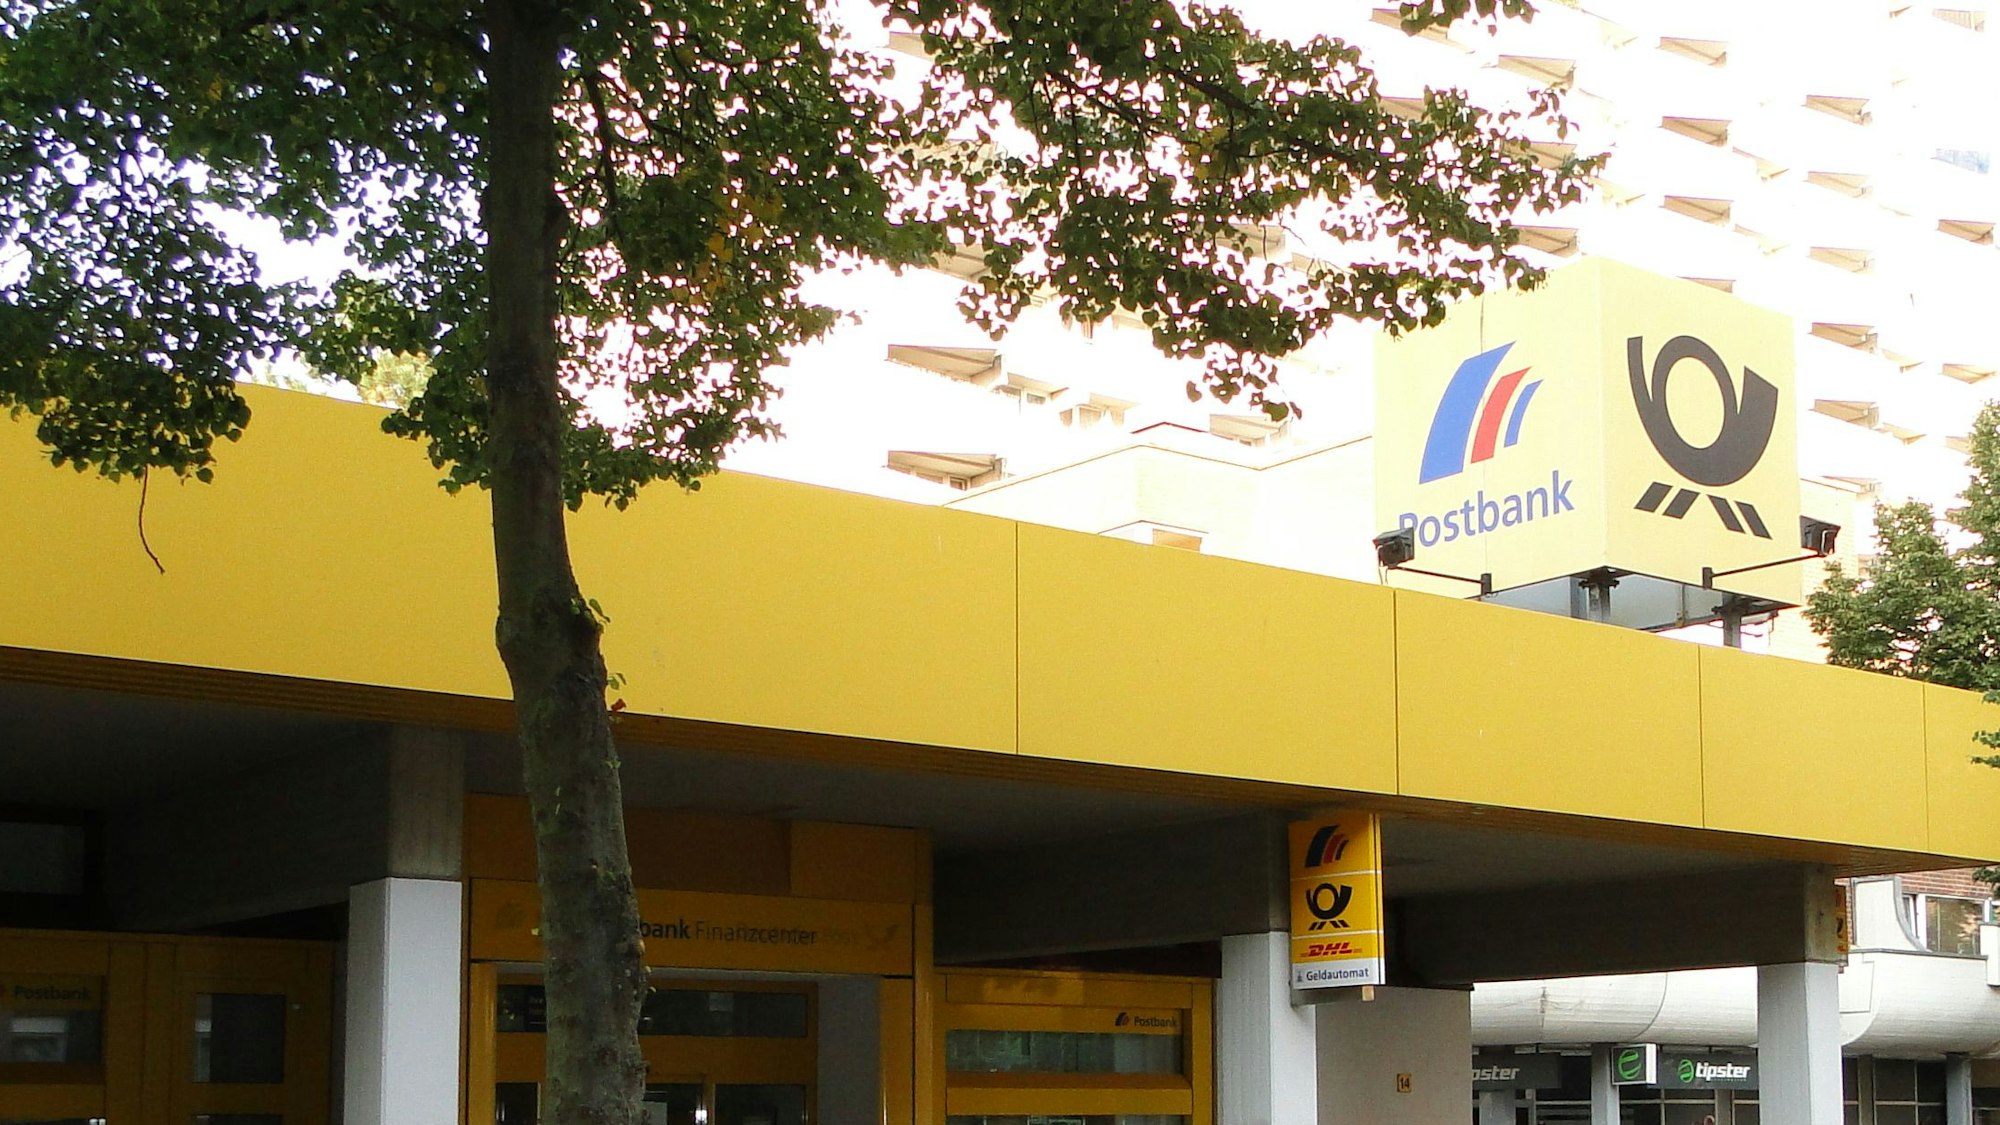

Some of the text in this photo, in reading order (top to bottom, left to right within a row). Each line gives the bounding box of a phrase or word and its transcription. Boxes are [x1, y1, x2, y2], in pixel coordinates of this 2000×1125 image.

[1399, 470, 1575, 547] Postbank
[639, 919, 690, 940] bank
[696, 920, 818, 945] Finanzcenter
[1308, 942, 1353, 957] DHL
[1306, 968, 1369, 981] Geldautomat
[1134, 1016, 1176, 1027] Postbank
[1472, 1065, 1520, 1081] pster
[1695, 1062, 1751, 1081] tipster
[1401, 1076, 1410, 1090] 14
